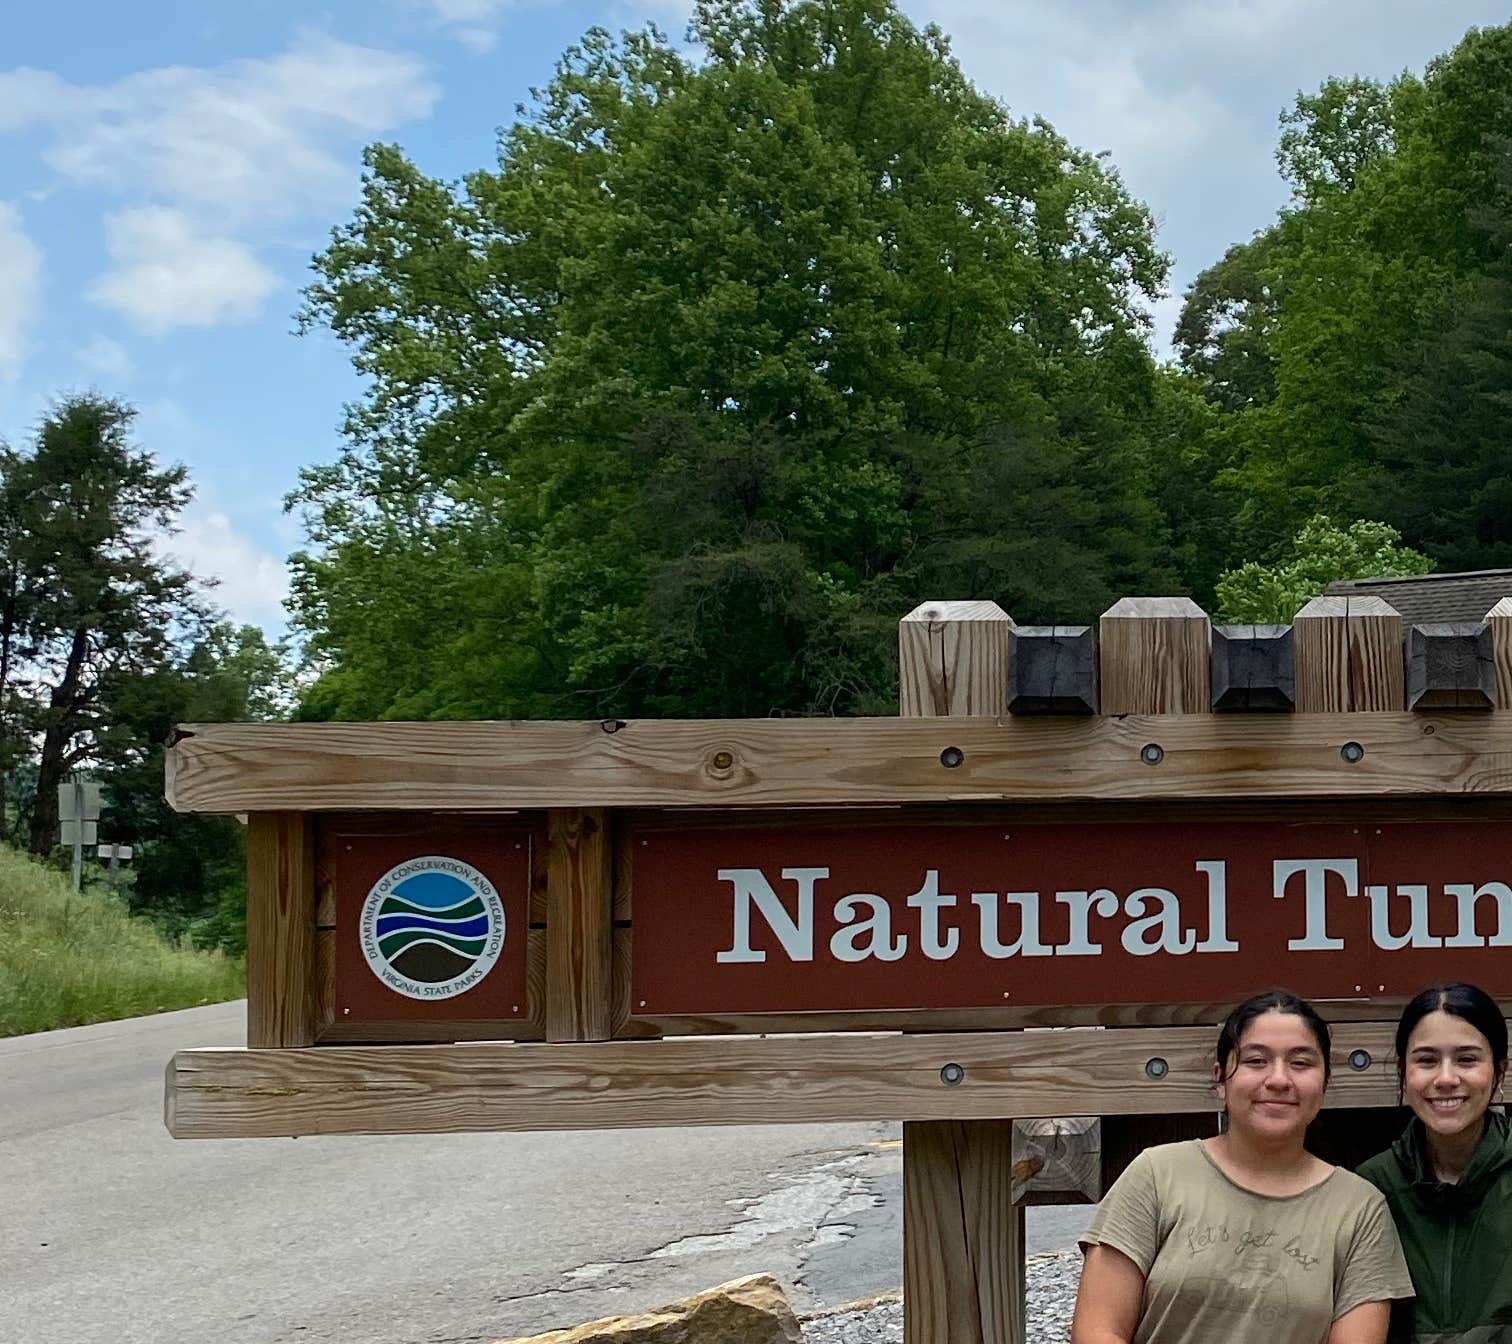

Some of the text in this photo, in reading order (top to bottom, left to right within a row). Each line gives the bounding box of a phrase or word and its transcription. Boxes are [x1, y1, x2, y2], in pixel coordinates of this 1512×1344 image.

[391, 860, 472, 881] CONSERVATION
[471, 875, 491, 895] AND
[716, 860, 1238, 966] Natural
[381, 968, 483, 996] VIRGINIA STATE PARKS
[1234, 1230, 1279, 1255] get
